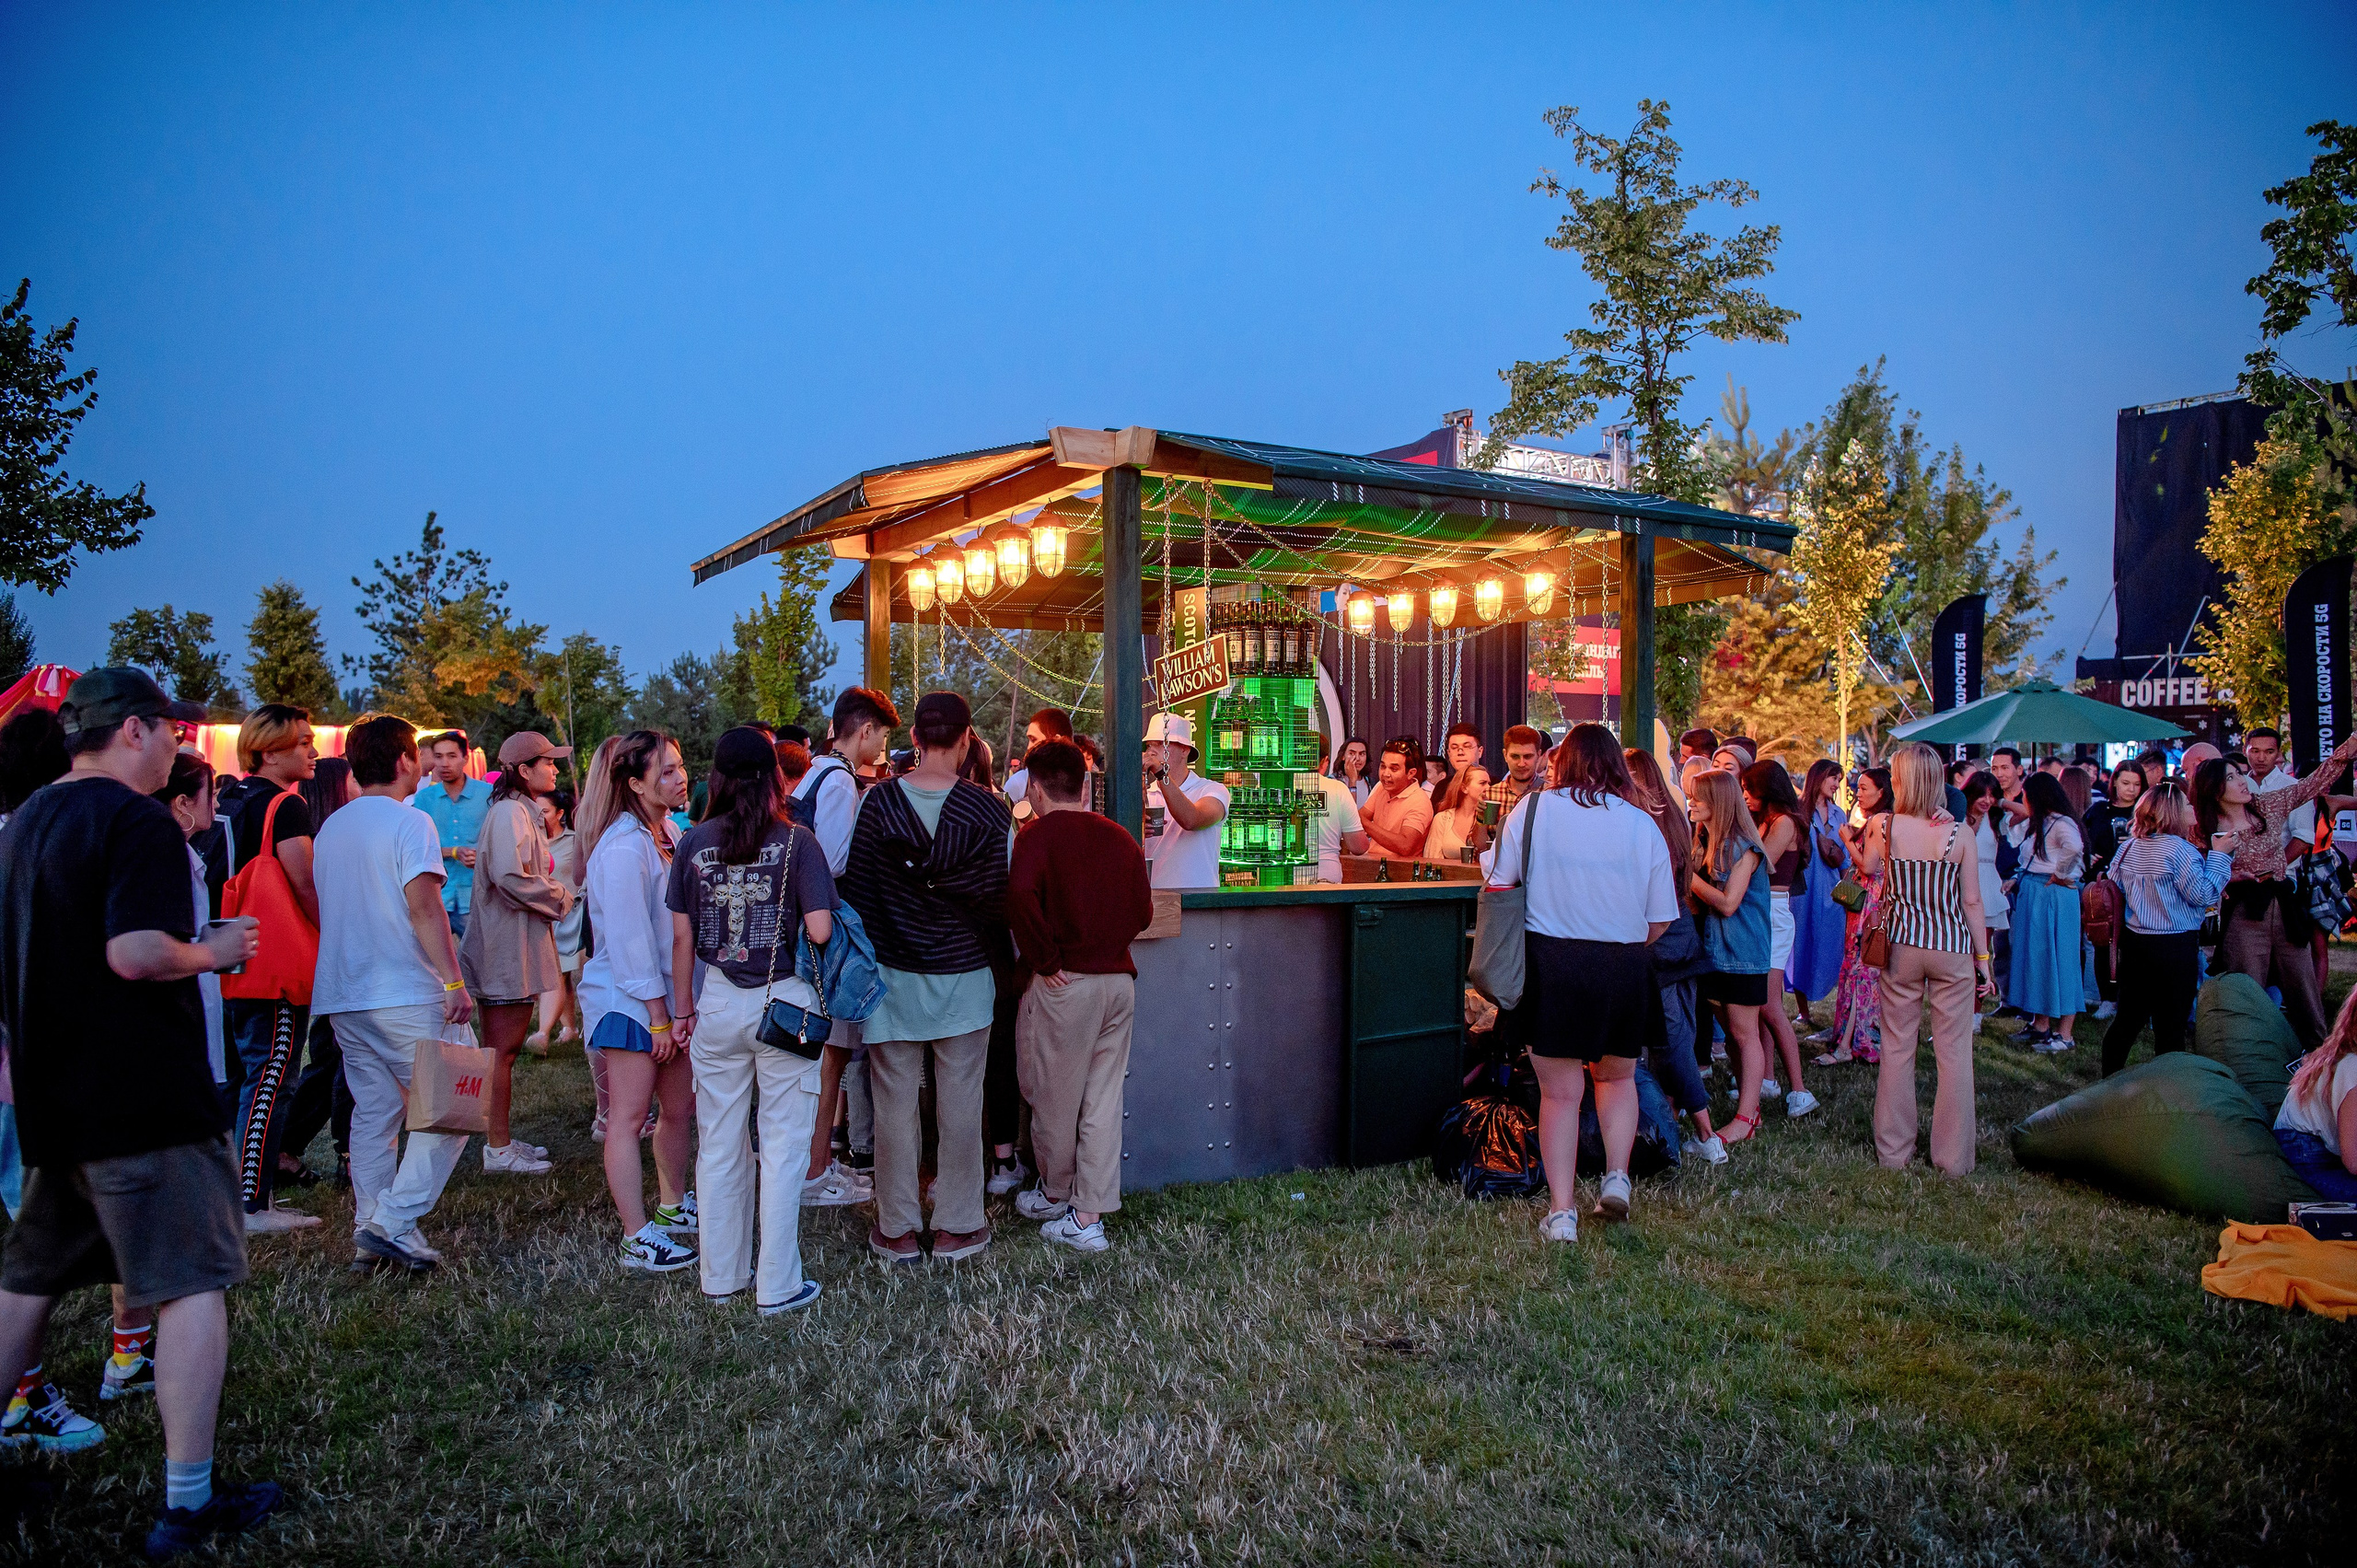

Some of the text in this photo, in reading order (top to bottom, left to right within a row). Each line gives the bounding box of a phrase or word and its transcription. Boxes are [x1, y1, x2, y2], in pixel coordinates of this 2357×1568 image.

[2314, 603, 2329, 623] 5G
[1955, 633, 1967, 650] 5G
[1161, 645, 1215, 679] WILLIAM
[2315, 625, 2332, 703] СКОРОСТИ
[1160, 663, 1223, 702] LAWSON'S
[1955, 651, 1968, 708] КОРОСТИ
[2121, 677, 2209, 707] COFFEE
[2318, 703, 2333, 726] НА
[455, 1074, 482, 1098] H&M
